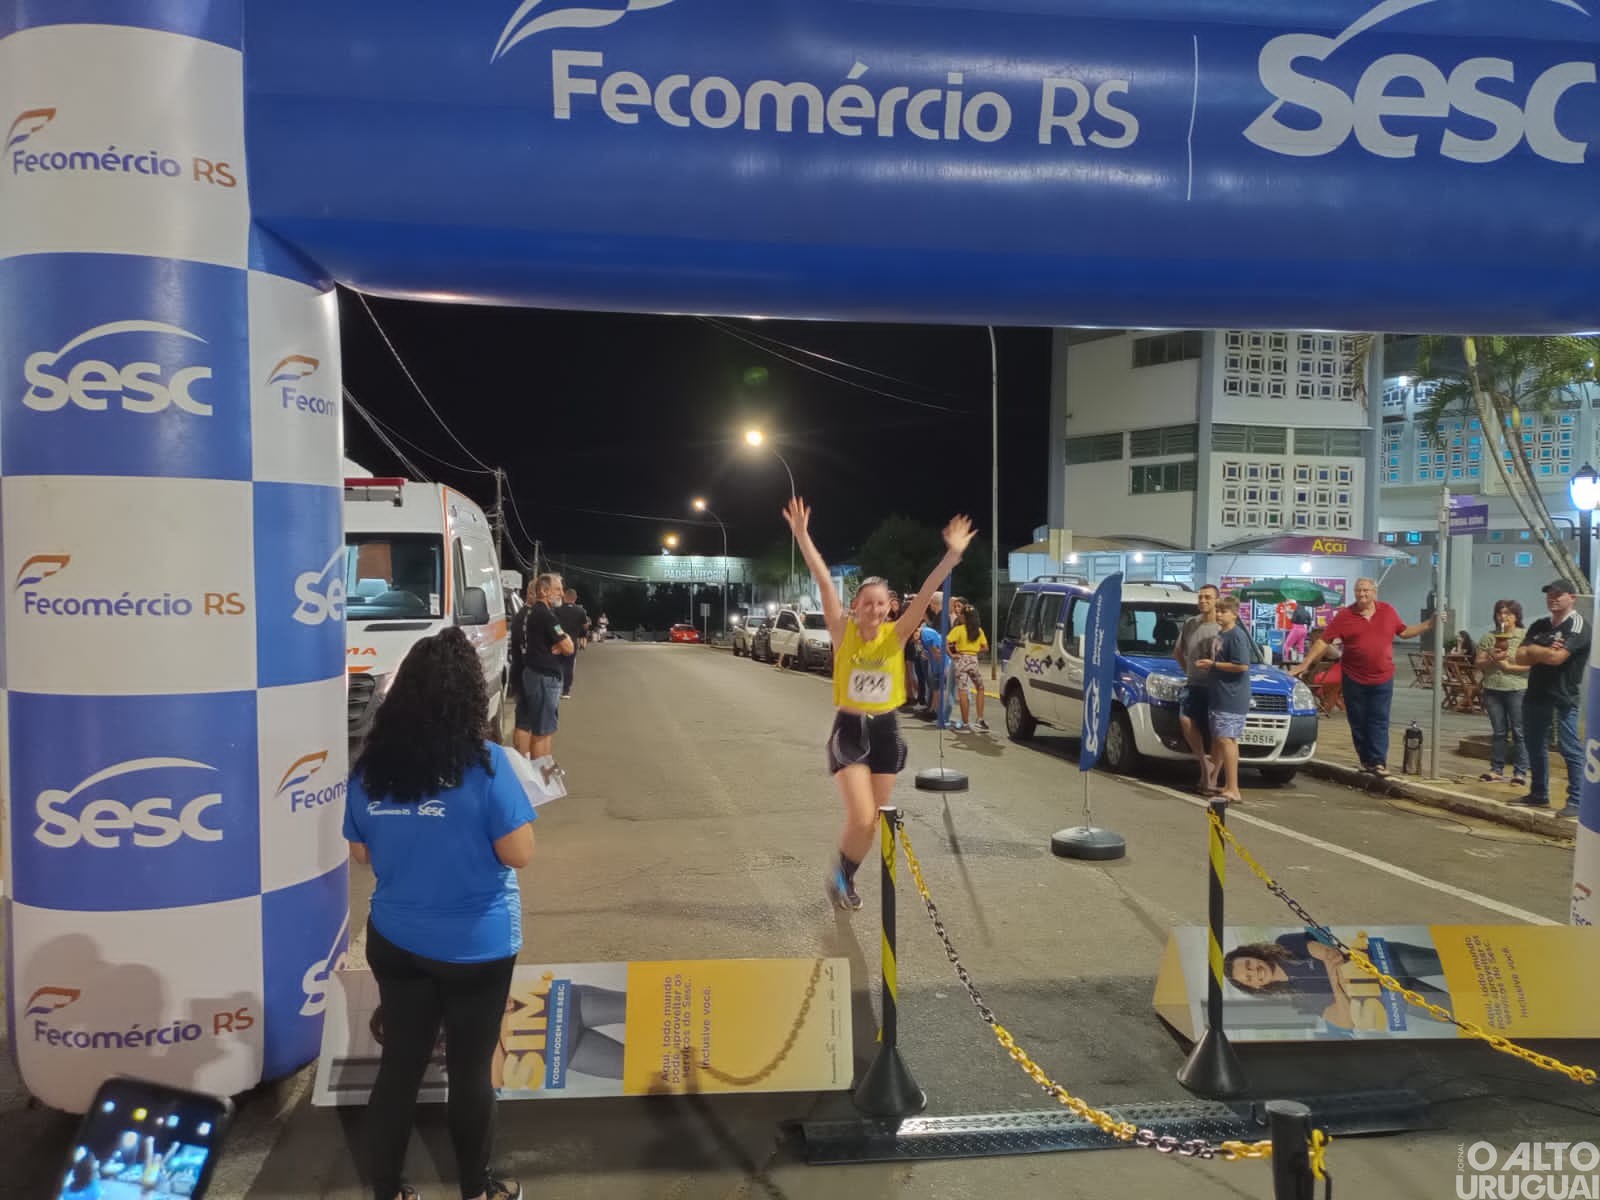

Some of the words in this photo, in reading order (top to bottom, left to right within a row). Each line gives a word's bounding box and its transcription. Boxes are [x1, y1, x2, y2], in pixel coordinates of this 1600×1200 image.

[551, 49, 1012, 142] Fecomércio
[1038, 77, 1140, 149] RS
[1242, 33, 1597, 164] Sesc
[13, 146, 182, 178] Fecomércio
[192, 157, 237, 188] RS
[22, 351, 213, 417] Sesc
[24, 592, 193, 616] Fecomércio
[203, 592, 246, 616] RS
[34, 789, 223, 848] Sesc
[1464, 936, 1481, 970] mundo
[661, 975, 673, 1017] mundo
[674, 973, 683, 987] os
[34, 1020, 203, 1050] Fecomércio
[213, 1006, 254, 1036] RS
[661, 1019, 672, 1048] todo
[681, 1011, 691, 1027] do
[700, 1018, 712, 1070] Inclusive
[671, 1054, 681, 1084] pode
